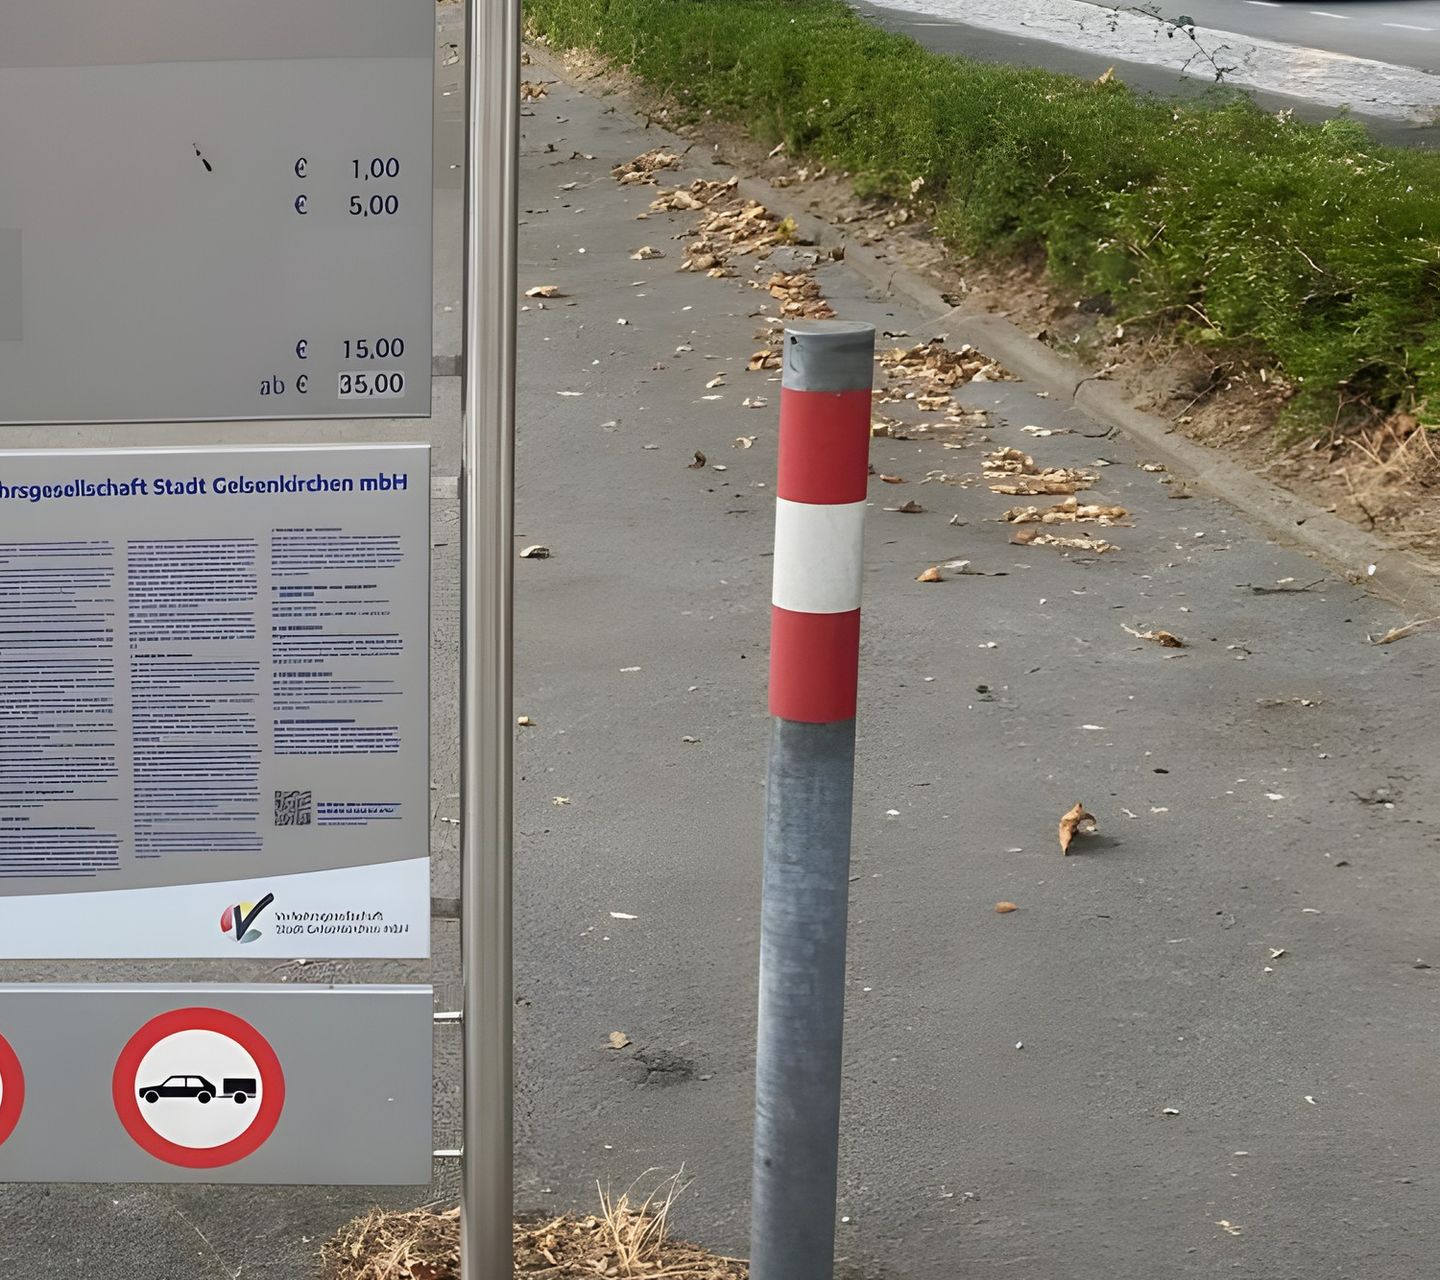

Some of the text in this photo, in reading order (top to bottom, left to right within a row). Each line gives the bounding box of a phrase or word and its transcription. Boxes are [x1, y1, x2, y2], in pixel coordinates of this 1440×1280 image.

[294, 157, 400, 181] € 1,00
[294, 194, 399, 217] € 5,00
[295, 337, 405, 360] € 15,00
[259, 372, 404, 396] ab € 35,00
[153, 476, 207, 496] Stadt
[212, 473, 354, 495] Gelsenkirchen
[359, 472, 408, 492] mbH
